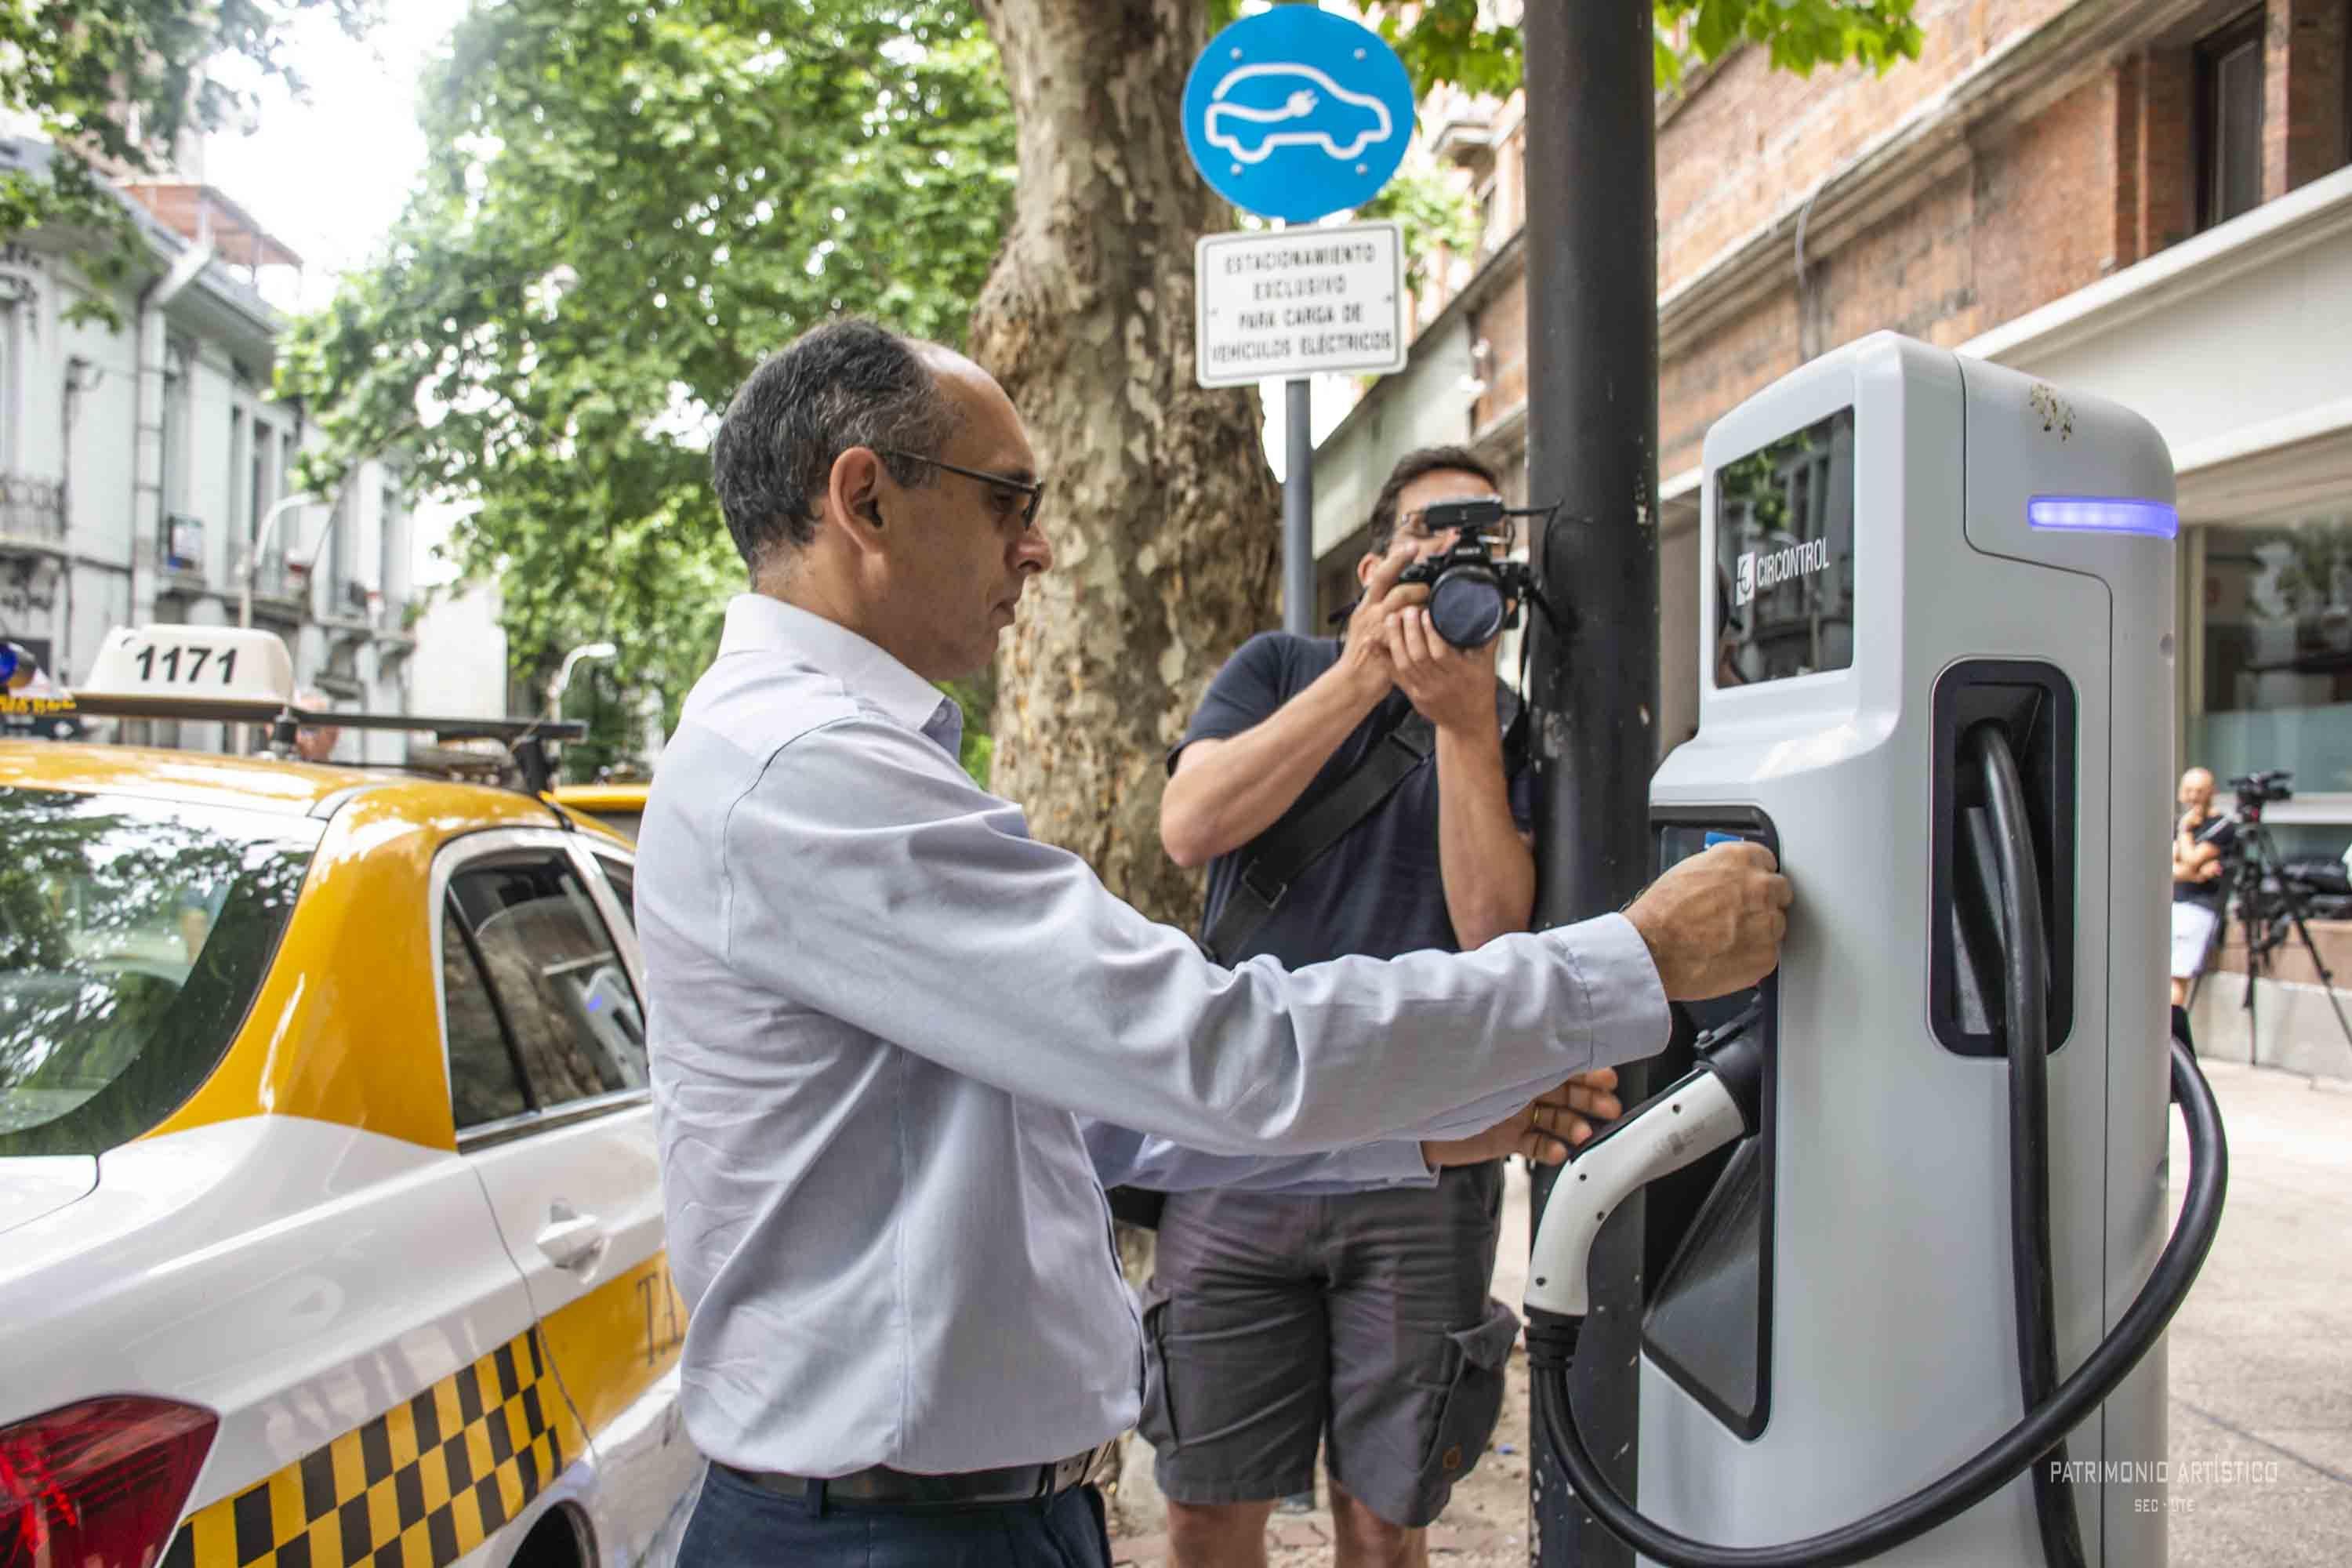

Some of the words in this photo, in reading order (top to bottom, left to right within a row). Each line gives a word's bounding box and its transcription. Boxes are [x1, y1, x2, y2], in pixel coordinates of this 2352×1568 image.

[1239, 311, 1274, 328] PARA
[1284, 305, 1334, 326] CARGA
[1342, 303, 1363, 323] DE
[1757, 537, 1831, 587] CIRCONTROL
[135, 643, 238, 684] 1171
